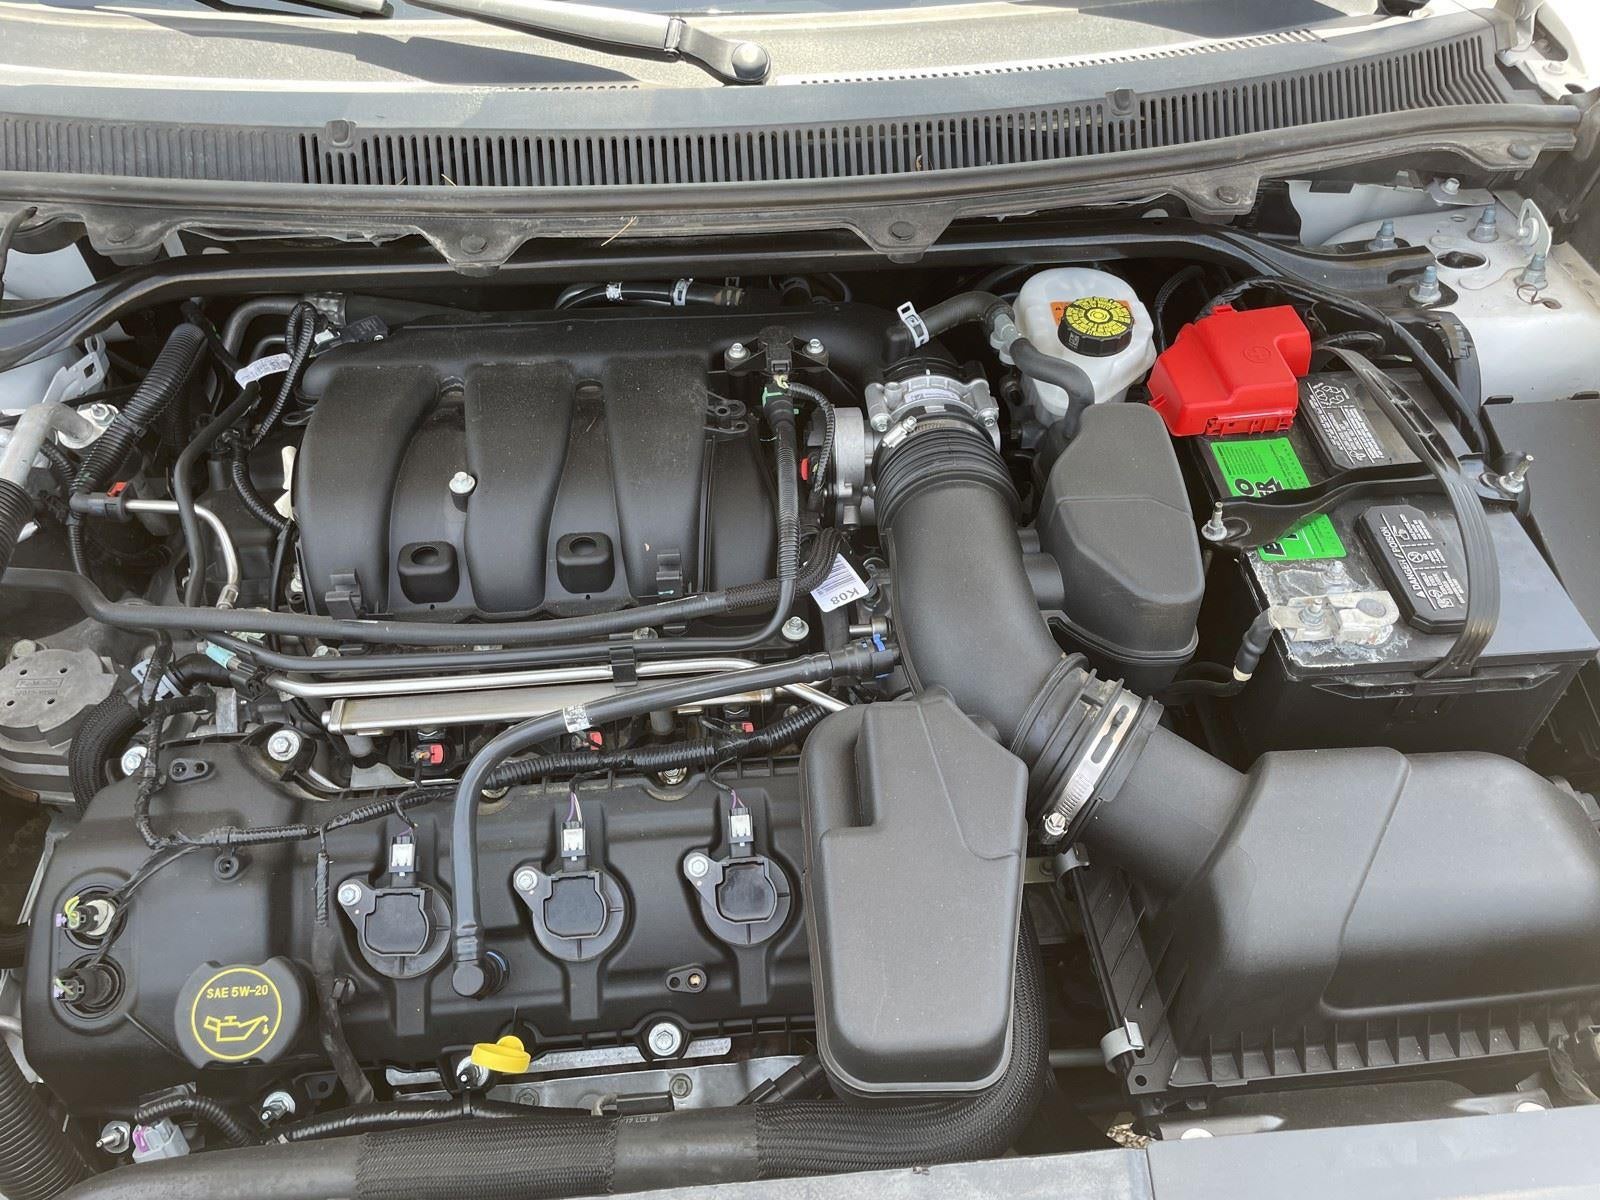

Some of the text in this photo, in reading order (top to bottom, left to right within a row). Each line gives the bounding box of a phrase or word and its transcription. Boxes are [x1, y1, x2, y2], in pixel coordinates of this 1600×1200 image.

[830, 588, 859, 605] K08
[206, 985, 268, 999] SAE 5W-20
